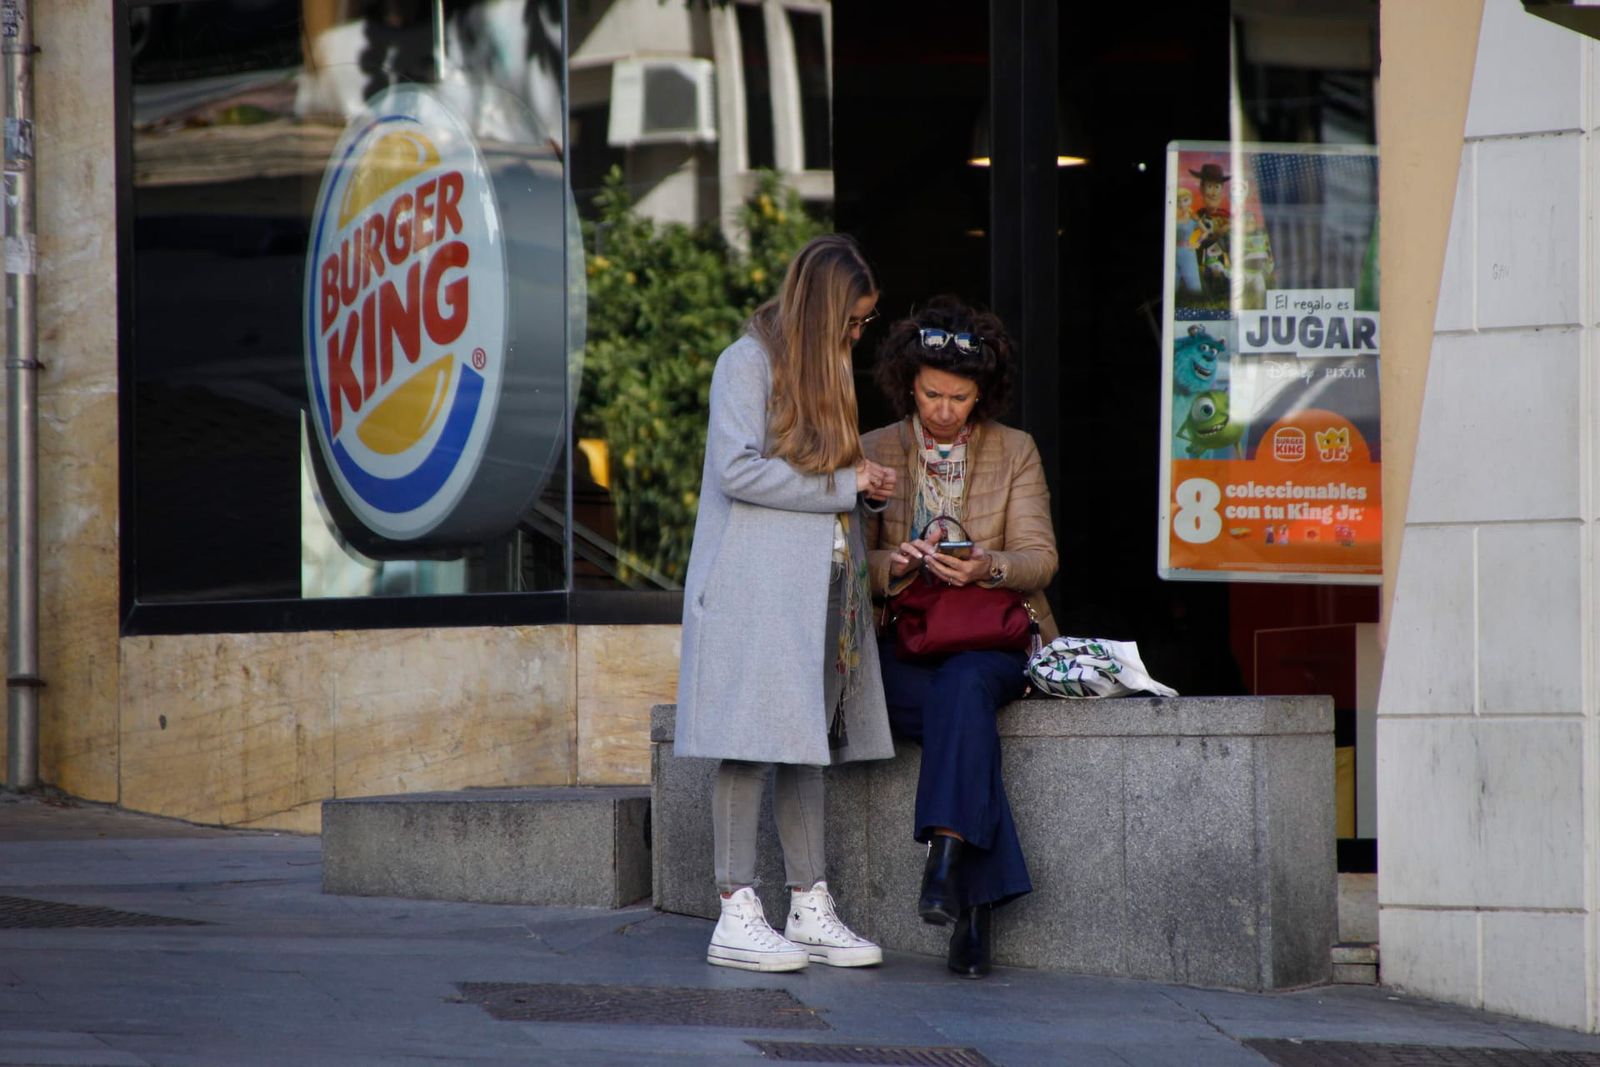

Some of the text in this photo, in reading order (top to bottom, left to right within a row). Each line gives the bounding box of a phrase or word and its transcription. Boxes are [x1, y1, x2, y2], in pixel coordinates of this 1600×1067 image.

[321, 171, 464, 335] BURGER
[1275, 295, 1350, 314] El regalo es
[327, 241, 469, 439] KING
[1246, 315, 1377, 350] JUGAR
[1325, 367, 1366, 378] PIXAR
[1276, 445, 1304, 454] KING
[1225, 481, 1367, 500] coleccionables
[1173, 478, 1223, 543] 8
[1225, 505, 1260, 519] con
[1264, 505, 1284, 520] tu
[1287, 503, 1333, 524] King
